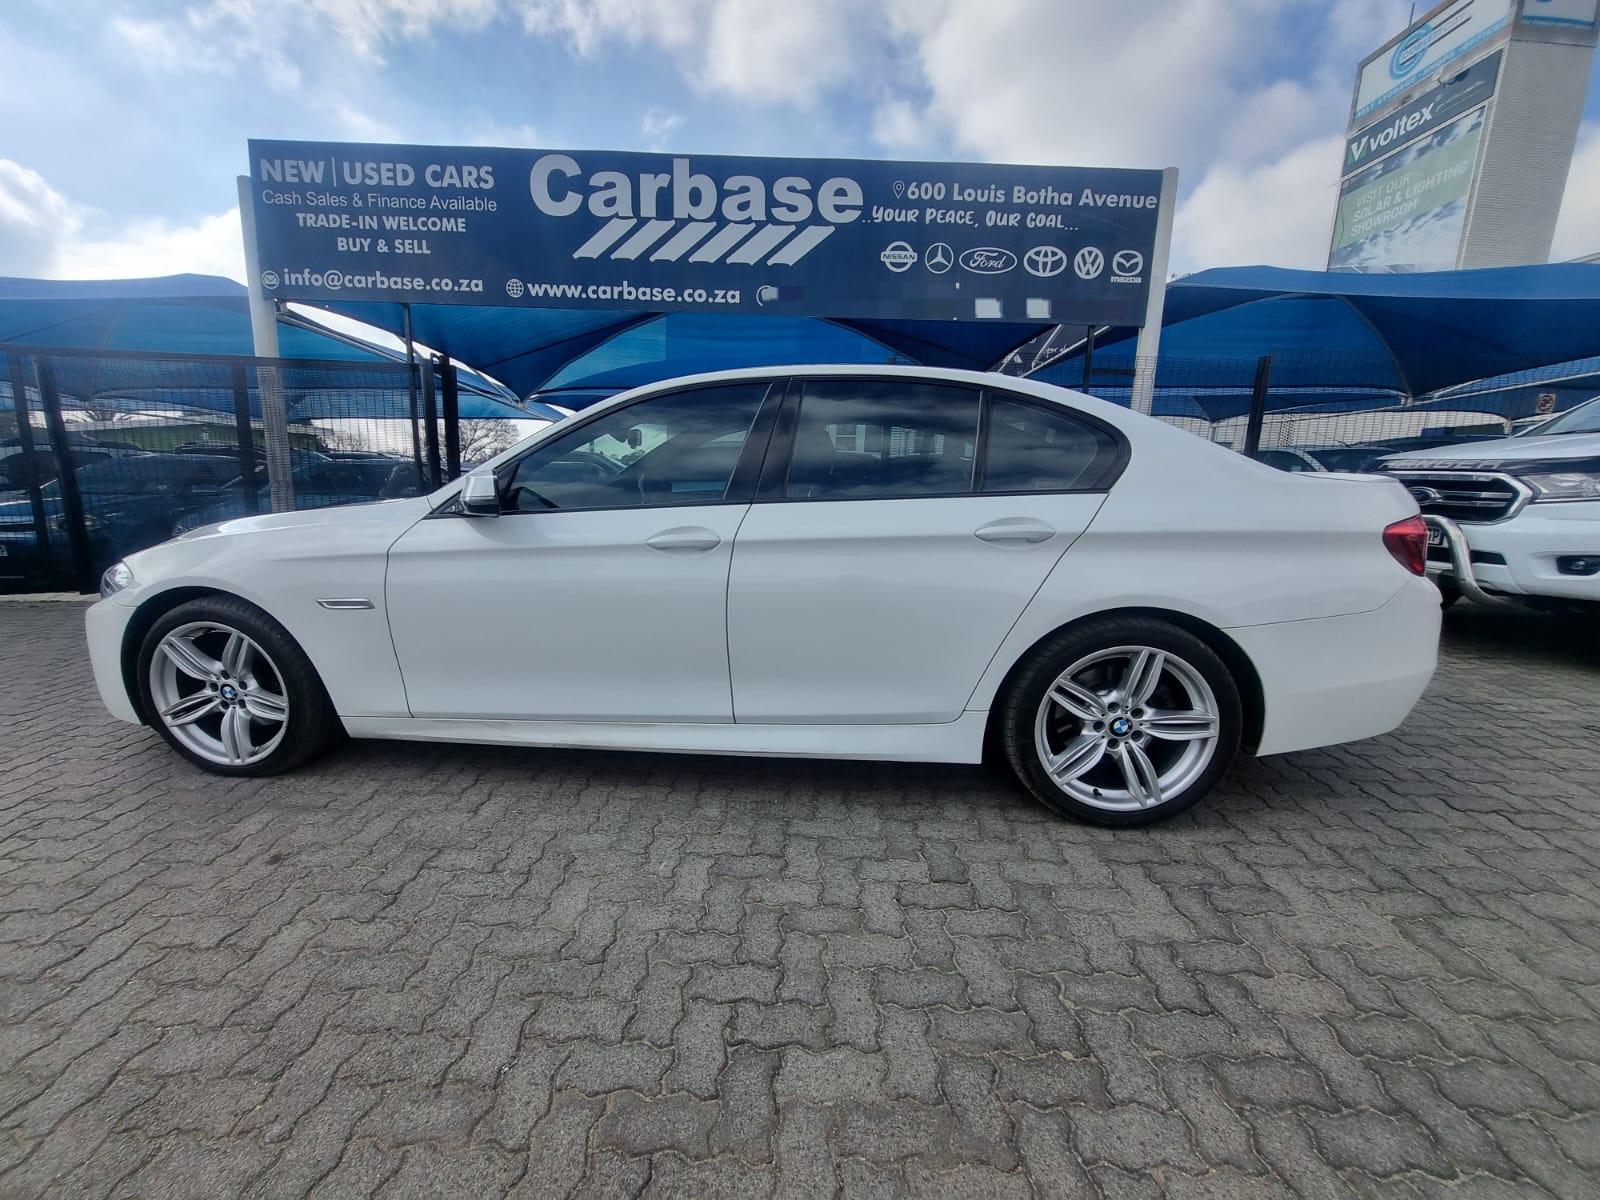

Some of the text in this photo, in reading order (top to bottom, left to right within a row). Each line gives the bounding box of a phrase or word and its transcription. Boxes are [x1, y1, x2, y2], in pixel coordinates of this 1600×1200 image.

[1370, 102, 1435, 152] voltex
[260, 158, 495, 190] NEW USED CARS
[262, 188, 498, 212] Cash Sales & Finance Available
[529, 153, 864, 224] Carbase
[906, 181, 1158, 209] 600 Louis Botha Avenue
[1353, 196, 1392, 222] SOLAR
[1405, 165, 1467, 198] LIGHTING
[1356, 172, 1413, 207] VISIT OUR
[296, 212, 467, 233] TRADE-IN WELCOME
[925, 207, 979, 228] PEACE,
[985, 209, 1021, 228] OUR
[1350, 198, 1418, 236] SHOWROOM
[336, 236, 431, 255] BUY & SELL
[882, 252, 917, 262] NISSAN
[969, 250, 1008, 270] Ford
[284, 268, 483, 293] info@carbase.co.za
[526, 280, 741, 304] www.carbase.co.za
